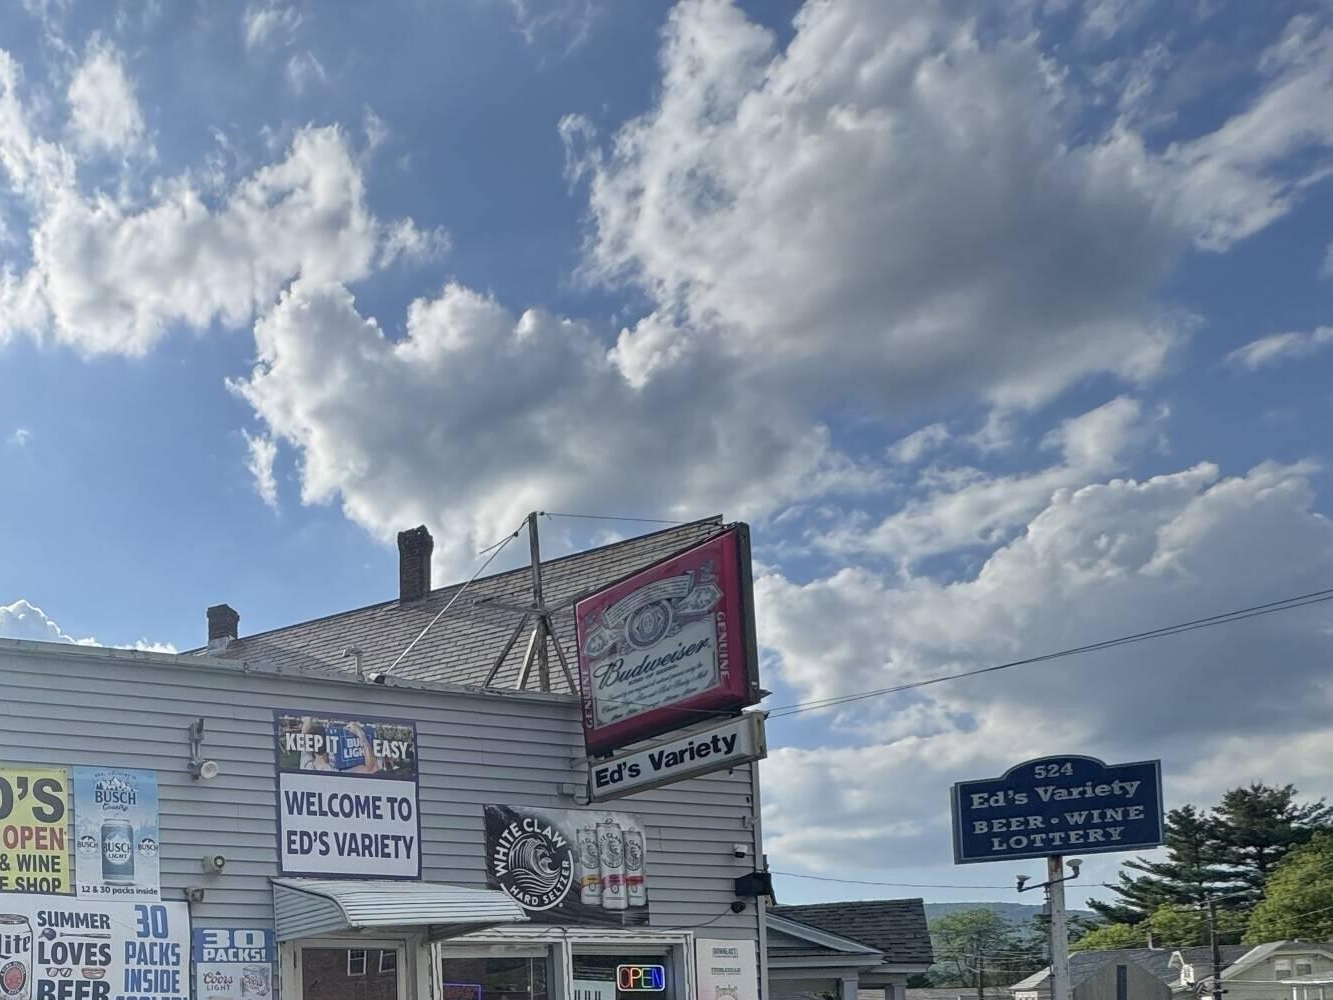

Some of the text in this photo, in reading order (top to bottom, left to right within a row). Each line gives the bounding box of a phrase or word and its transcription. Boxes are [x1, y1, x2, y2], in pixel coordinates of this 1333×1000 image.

[717, 610, 731, 680] GENUINE
[593, 636, 710, 690] Budweiser
[581, 670, 594, 729] GENUINE
[285, 732, 409, 759] KEEP IT EASY
[595, 731, 738, 789] Ed's Variety
[1034, 762, 1074, 779] 524
[95, 790, 136, 805] BUSCH
[284, 790, 412, 822] WELCOME TO
[970, 779, 1141, 809] Ed's Variety
[973, 805, 1145, 834] BEER WINE
[3, 825, 64, 851] OPEN
[286, 830, 414, 859] ED'S VARIETY
[494, 818, 566, 877] WHITE CLAW
[991, 826, 1125, 850] LOTTERY
[16, 854, 61, 873] WINE
[15, 877, 61, 893] SHOP
[112, 887, 134, 895] packs
[136, 887, 158, 895] inside
[510, 859, 570, 905] HARD SELTZER
[37, 910, 111, 929] SUMMER
[134, 904, 169, 938] 30
[202, 929, 265, 949] 30
[37, 941, 112, 966] LOVES
[124, 940, 181, 966] PACKS
[202, 949, 266, 962] PACKS!
[124, 968, 180, 993] INSIDE
[203, 971, 233, 985] Coors
[206, 984, 230, 992] LIGHT
[618, 967, 663, 989] OPEN
